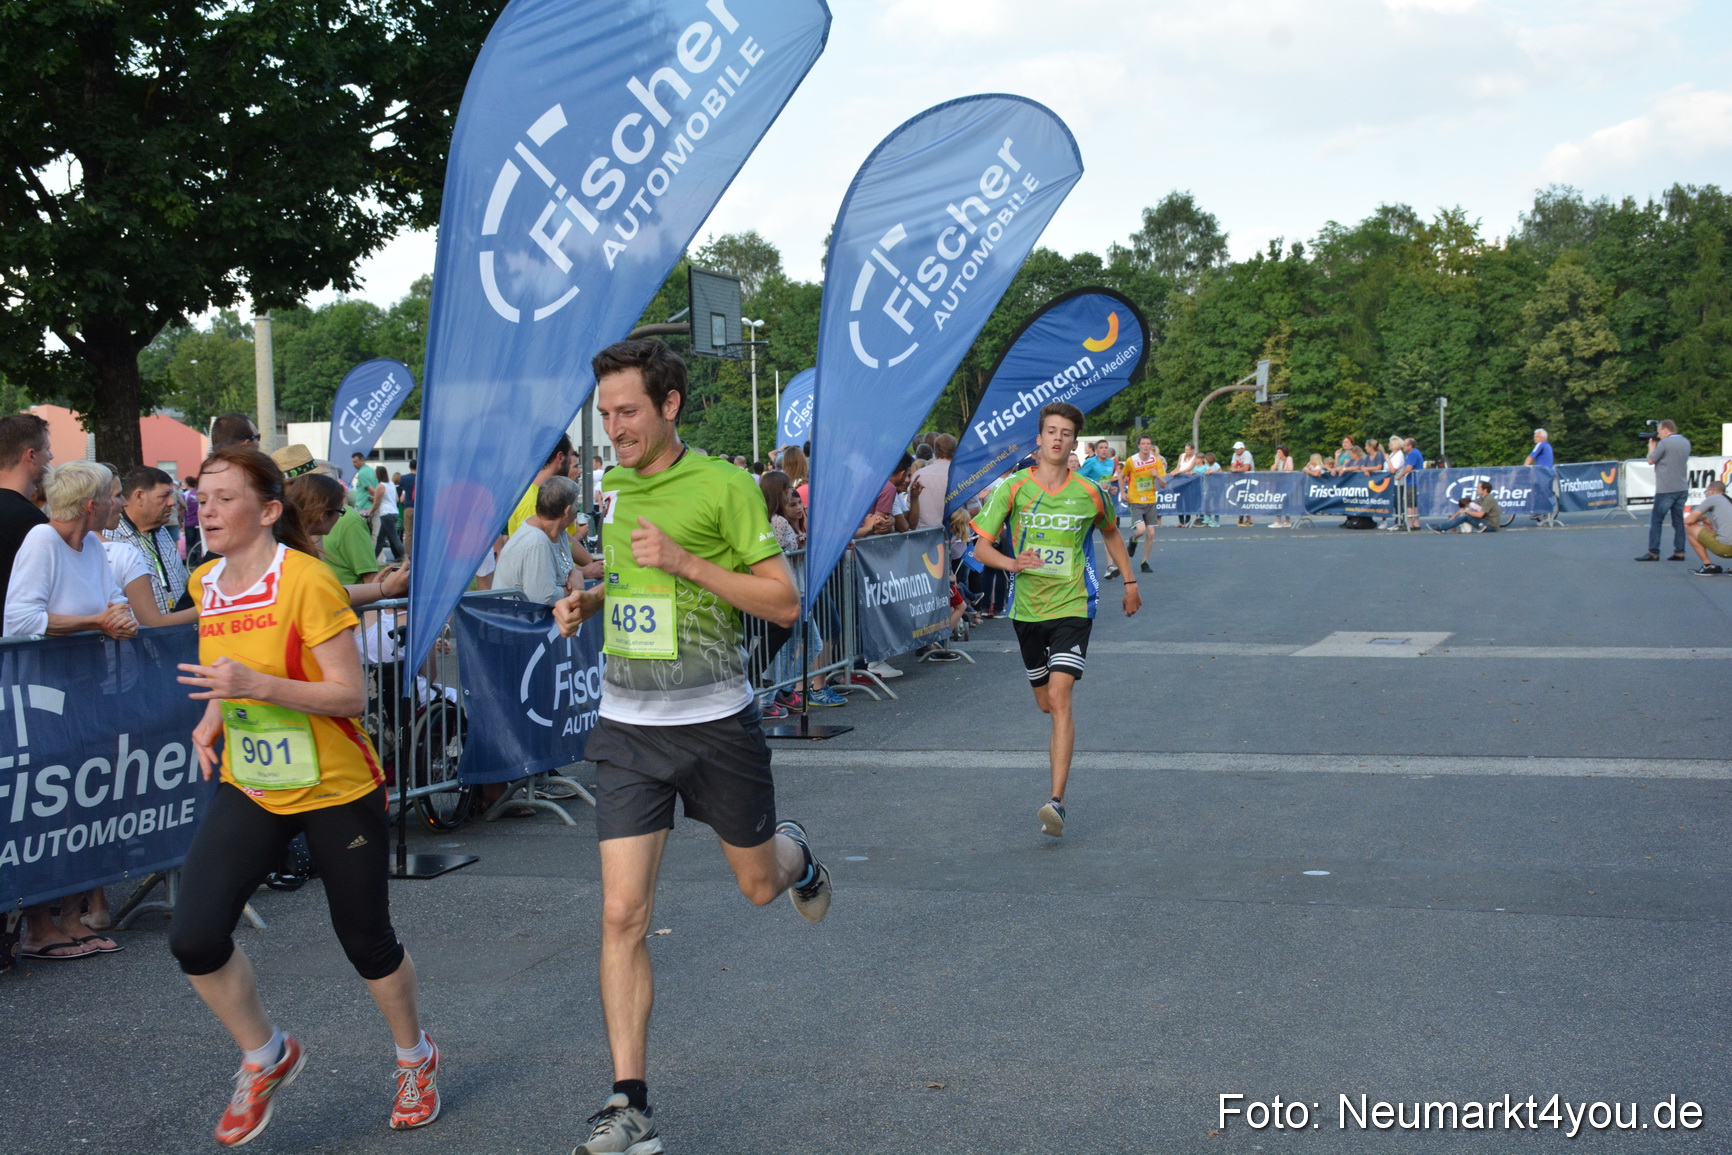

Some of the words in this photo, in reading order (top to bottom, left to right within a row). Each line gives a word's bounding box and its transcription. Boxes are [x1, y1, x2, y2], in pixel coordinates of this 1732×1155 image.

[529, 0, 740, 275] Fischer
[604, 36, 765, 271] AUTOMOBILE
[882, 136, 1023, 336] Fischer
[932, 172, 1040, 332] AUTOMOBILE
[1052, 384, 1081, 405] Druck
[1082, 372, 1101, 388] und
[1101, 344, 1138, 376] Medien
[350, 372, 396, 434] Fischer
[366, 383, 402, 434] AUTOMOBILE
[973, 355, 1095, 445] Frischmann
[1237, 489, 1287, 503] Fischer
[1309, 484, 1369, 498] Frischmann
[1461, 486, 1532, 501] Ficher
[1560, 477, 1603, 493] Frischmann
[1019, 512, 1087, 530] BOCK
[864, 570, 932, 608] Frischmann
[230, 612, 278, 635] BÖGL
[611, 603, 657, 634] 483
[242, 736, 292, 767] 901
[0, 797, 196, 867] AUTOMOBILE
